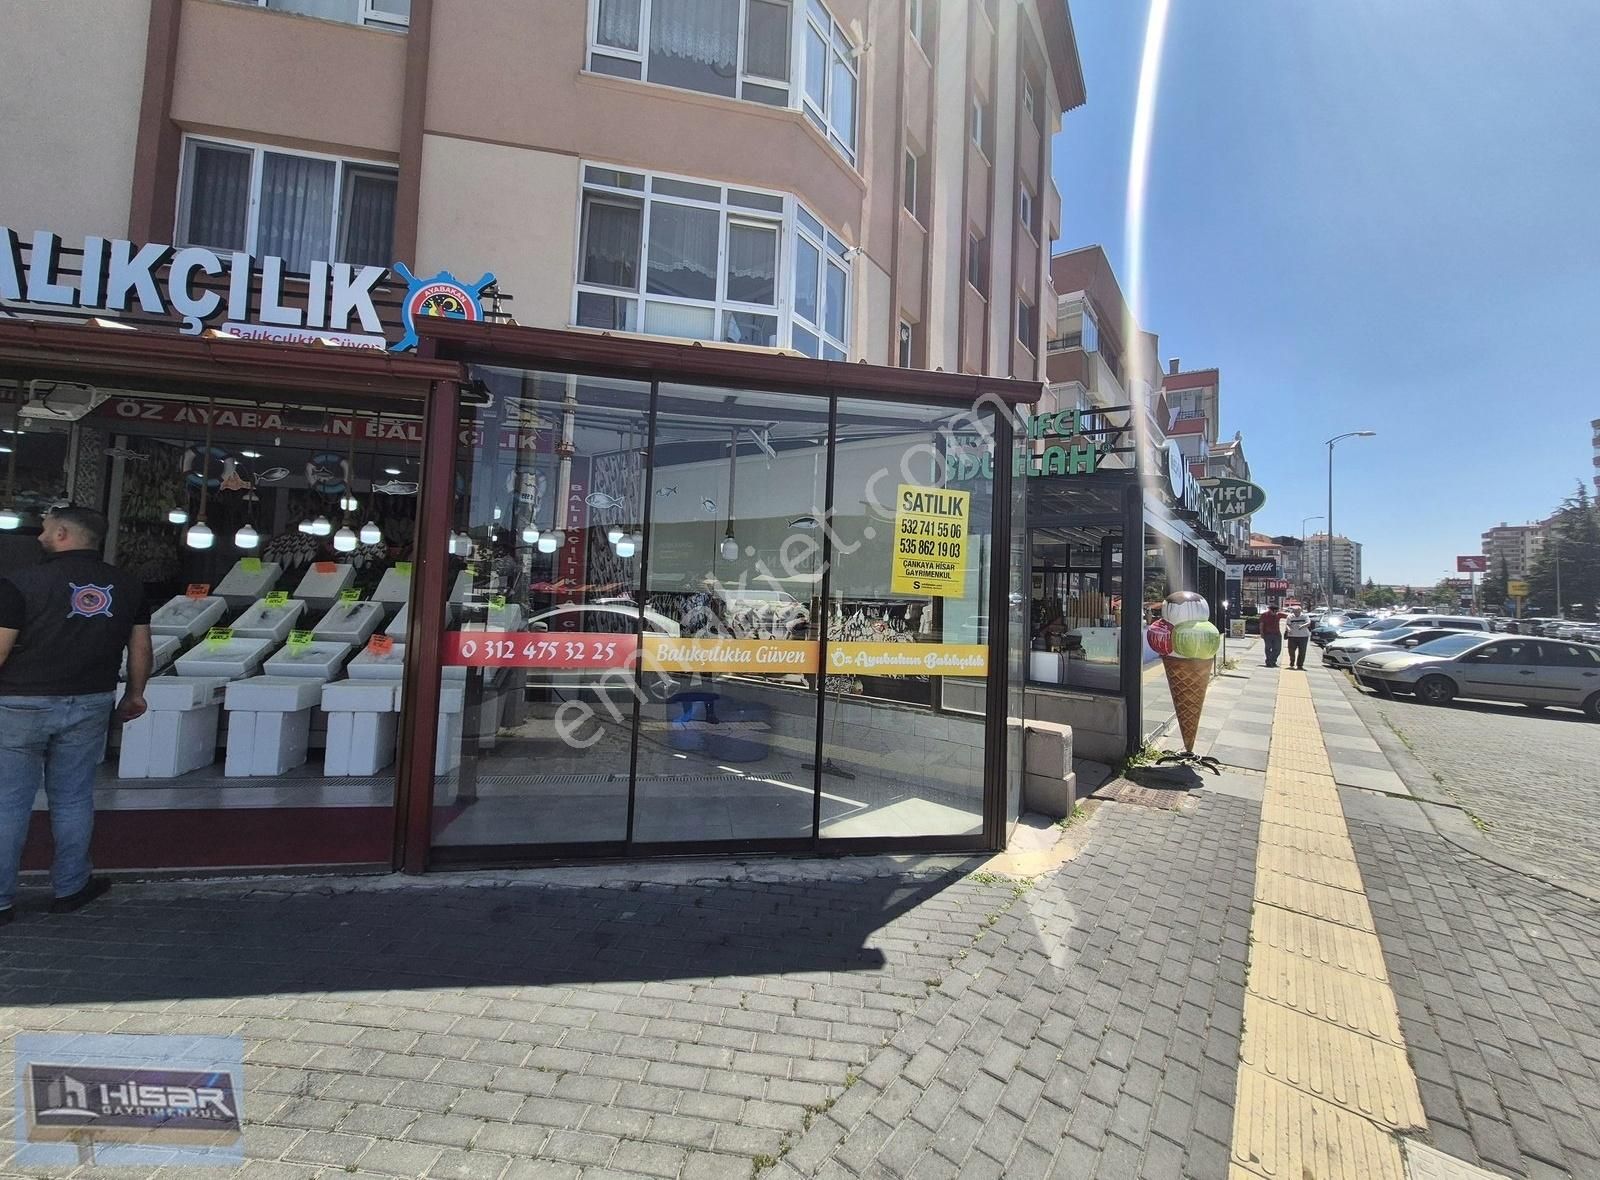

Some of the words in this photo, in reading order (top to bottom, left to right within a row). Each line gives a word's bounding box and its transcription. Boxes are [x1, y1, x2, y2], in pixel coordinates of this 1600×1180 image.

[424, 285, 468, 303] AYABAKAN
[116, 399, 163, 420] ÖZ
[173, 406, 352, 435] AYABAN
[903, 491, 963, 516] SATILIK
[1217, 502, 1246, 515] LAH
[901, 518, 918, 535] 532
[920, 520, 935, 536] 741
[937, 522, 949, 537] 55
[950, 523, 962, 539] 06
[900, 538, 917, 554] 535
[918, 540, 934, 556] 862
[938, 541, 948, 557] 19
[949, 543, 960, 558] 03
[903, 560, 934, 570] ÇANKAYA
[935, 561, 955, 571] HİSAR
[905, 568, 952, 579] GAYRİMENKUL
[1242, 562, 1274, 574] rçelik
[462, 640, 477, 658] 0
[484, 640, 515, 660] 312
[522, 641, 560, 661] 475
[565, 641, 586, 661] 32
[592, 642, 616, 662] 25
[656, 644, 752, 665] Balıkçılıkta
[756, 645, 805, 663] Güven
